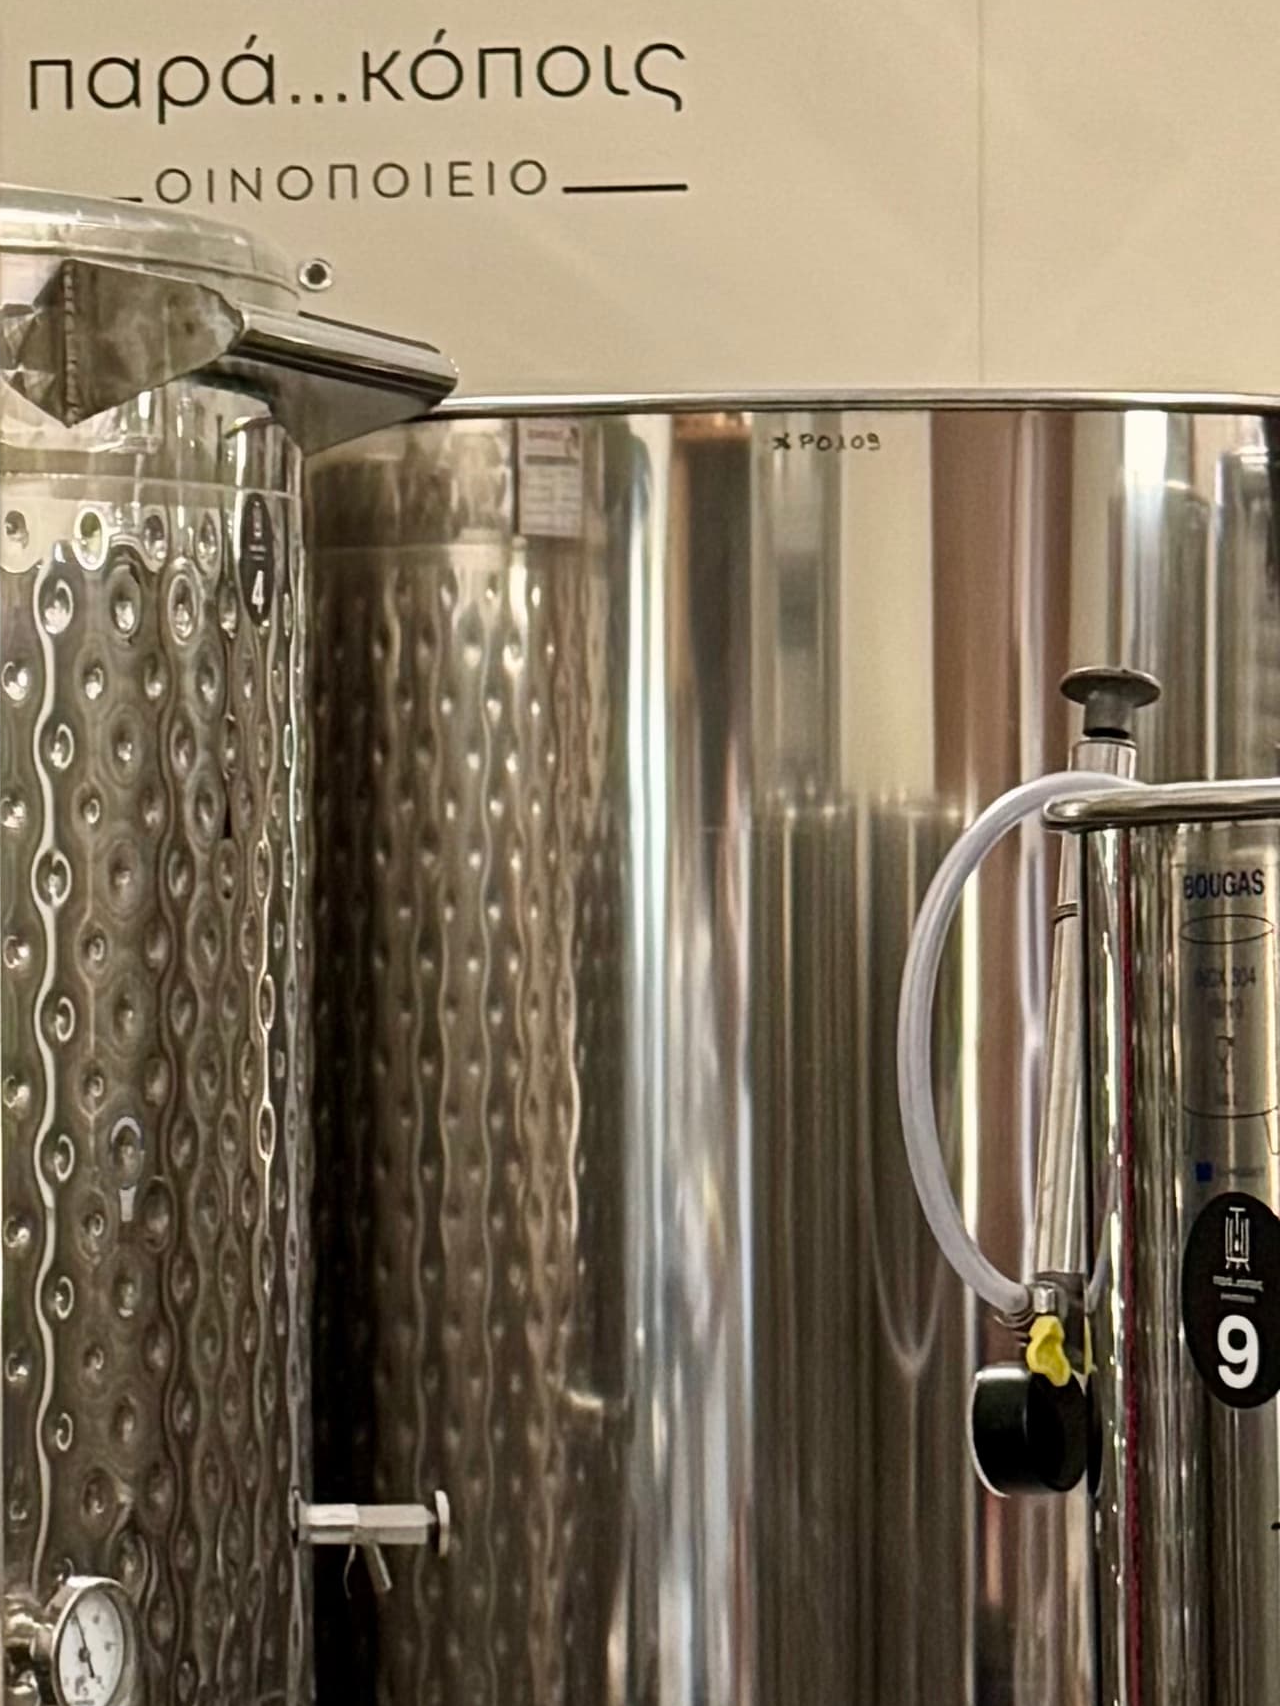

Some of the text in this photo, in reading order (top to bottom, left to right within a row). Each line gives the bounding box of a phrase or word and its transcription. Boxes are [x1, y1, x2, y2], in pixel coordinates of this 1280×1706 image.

[155, 159, 547, 204] ΟΙΝΟΠΟΙΕΙΟ
[251, 570, 264, 614] 4
[1183, 869, 1265, 899] BOUGAS
[1217, 1314, 1260, 1390] 9
